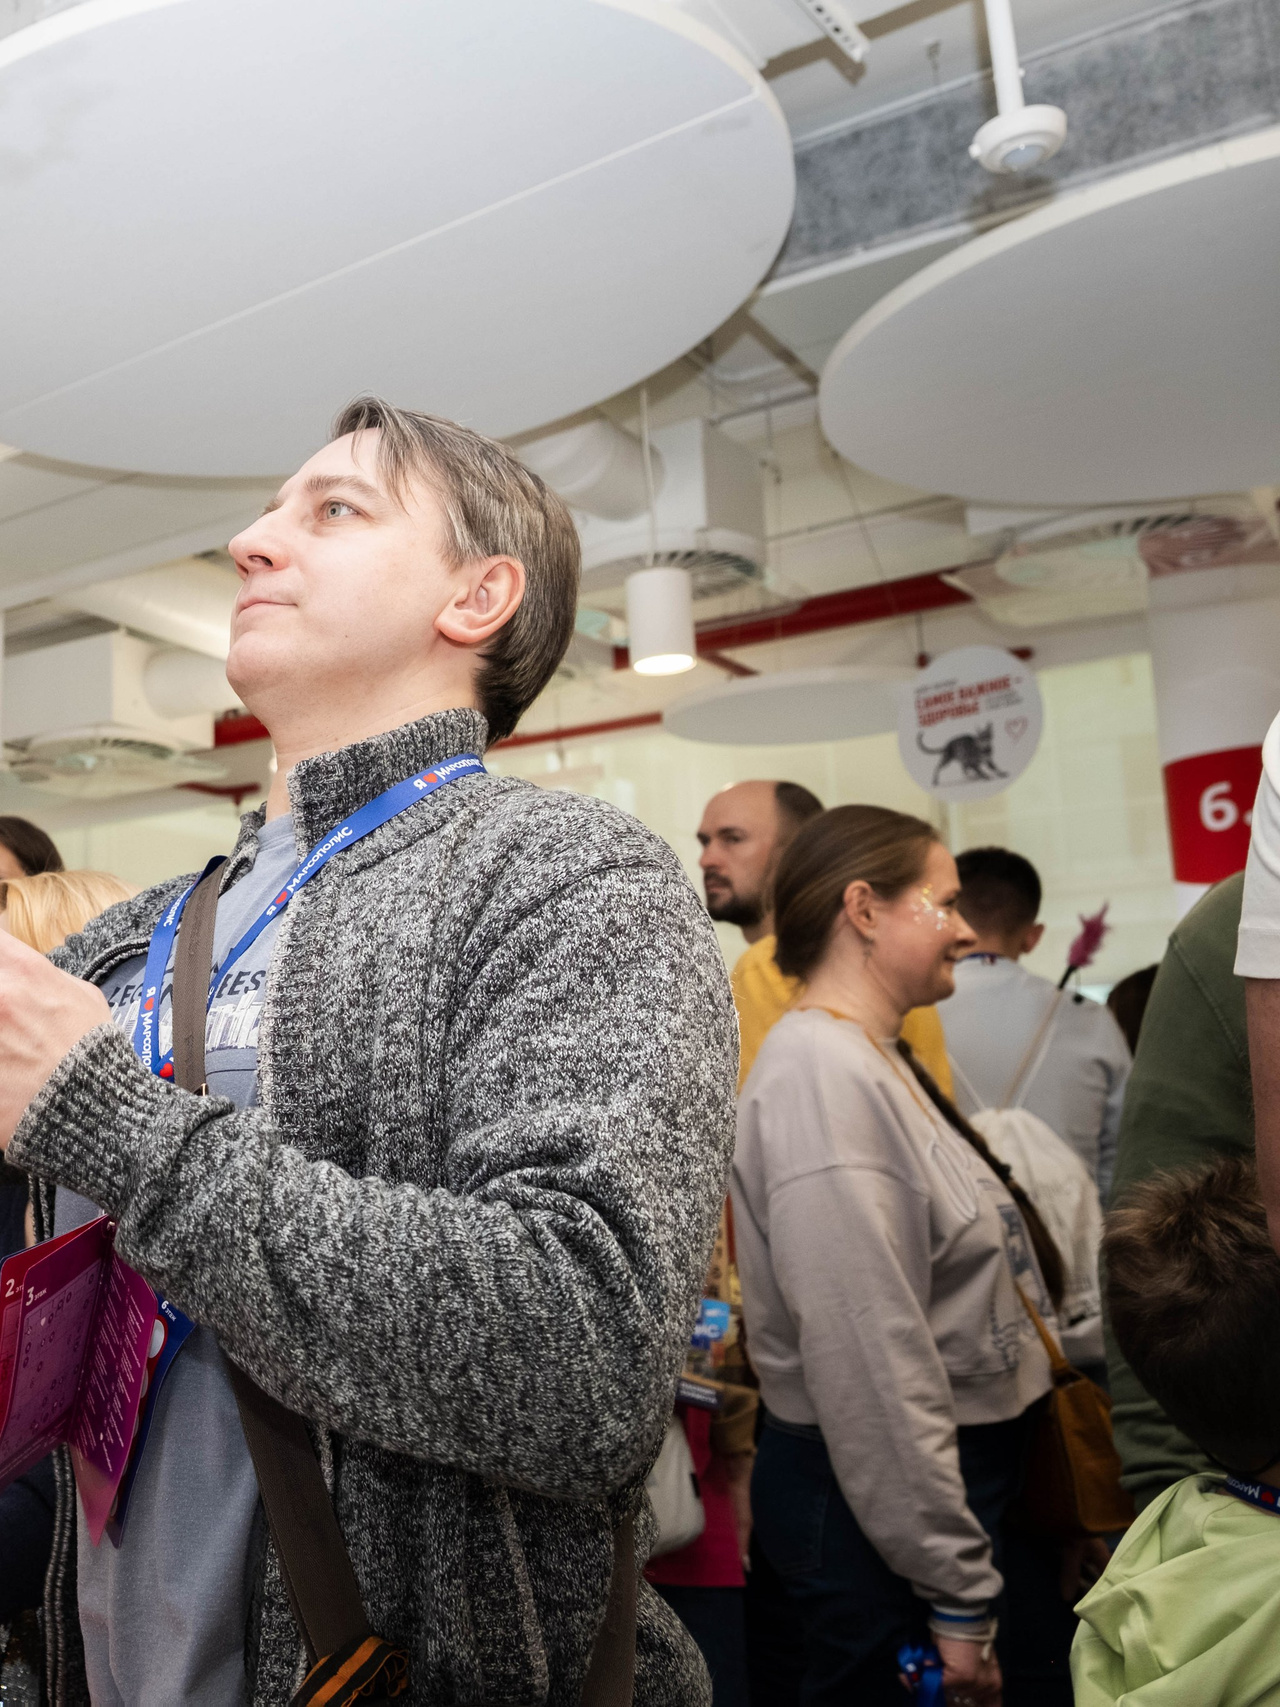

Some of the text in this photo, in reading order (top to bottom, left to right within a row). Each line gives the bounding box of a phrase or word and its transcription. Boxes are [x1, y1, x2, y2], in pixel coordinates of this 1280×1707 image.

[413, 779, 427, 790] Я
[266, 905, 277, 916] Я
[146, 986, 157, 998] Я
[5, 1278, 15, 1298] 2
[25, 1286, 35, 1307] 3
[161, 1300, 169, 1310] 6
